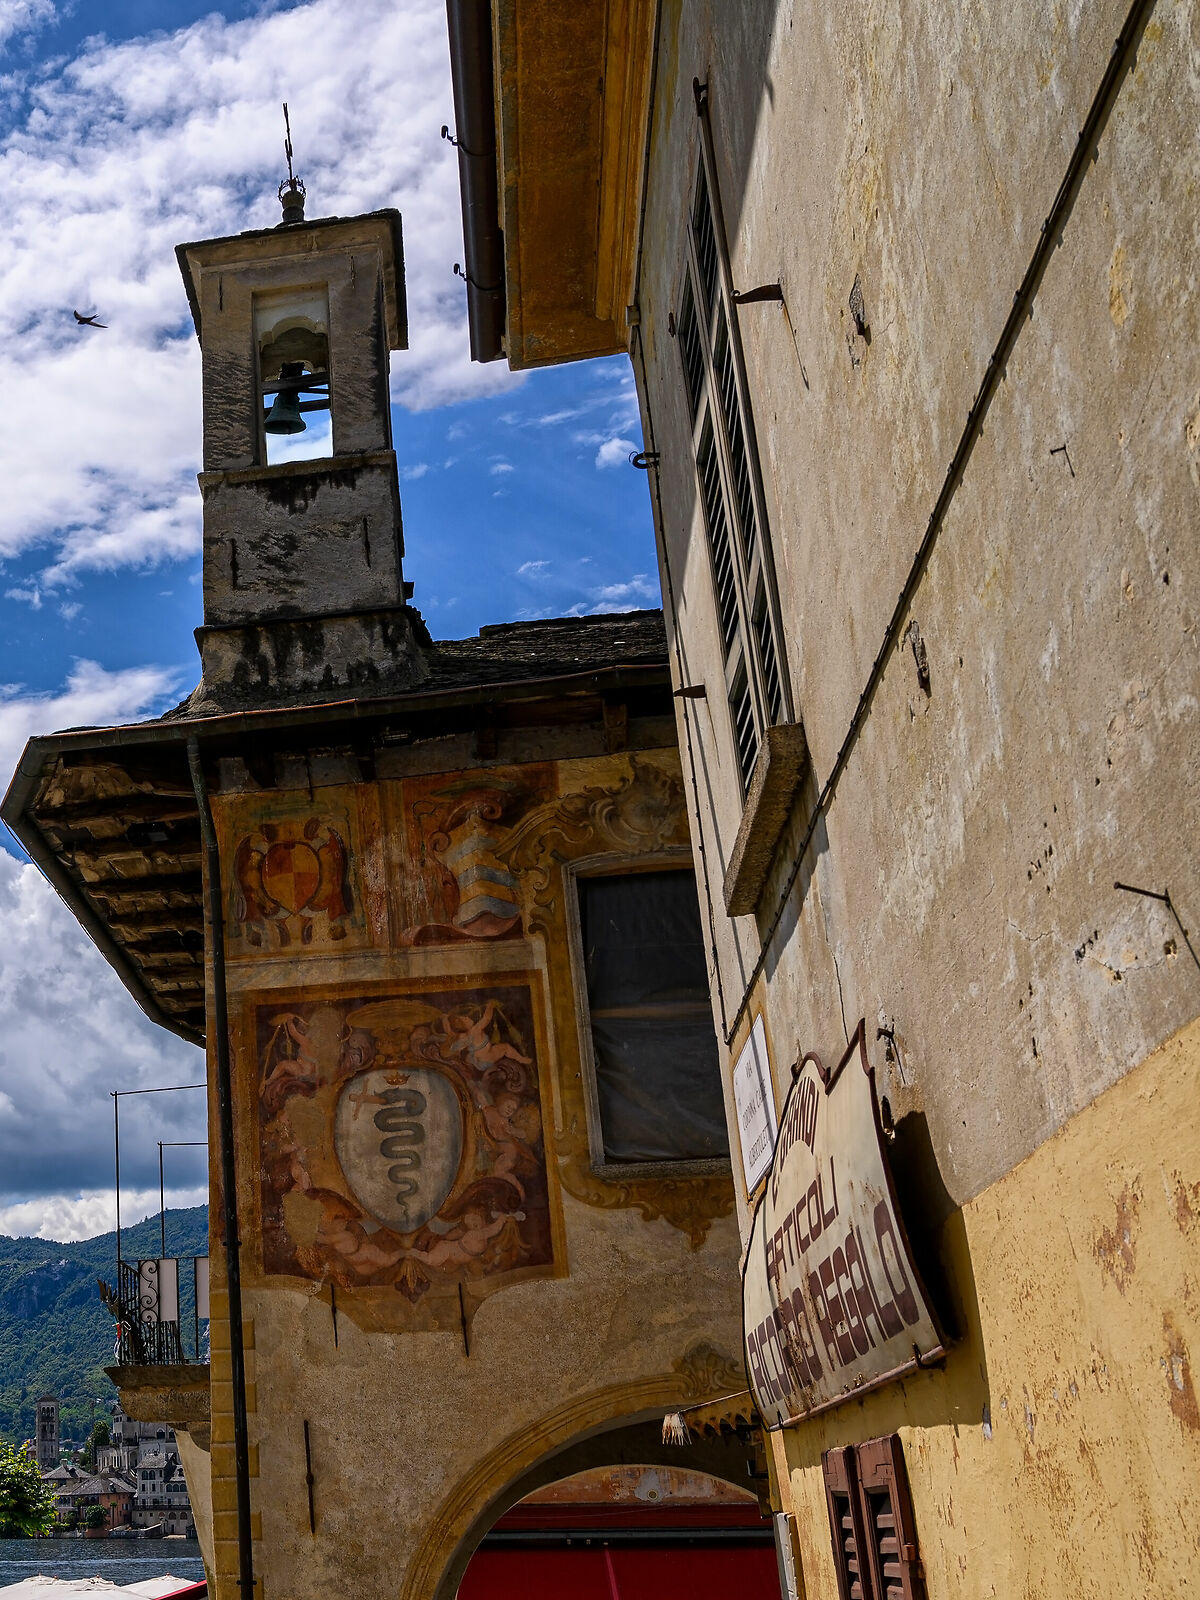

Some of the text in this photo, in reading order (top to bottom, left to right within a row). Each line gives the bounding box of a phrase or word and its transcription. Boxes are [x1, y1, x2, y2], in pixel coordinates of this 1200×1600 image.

[746, 1198, 920, 1409] RICORDO REGALO
[766, 1155, 840, 1292] ARTICOLI
